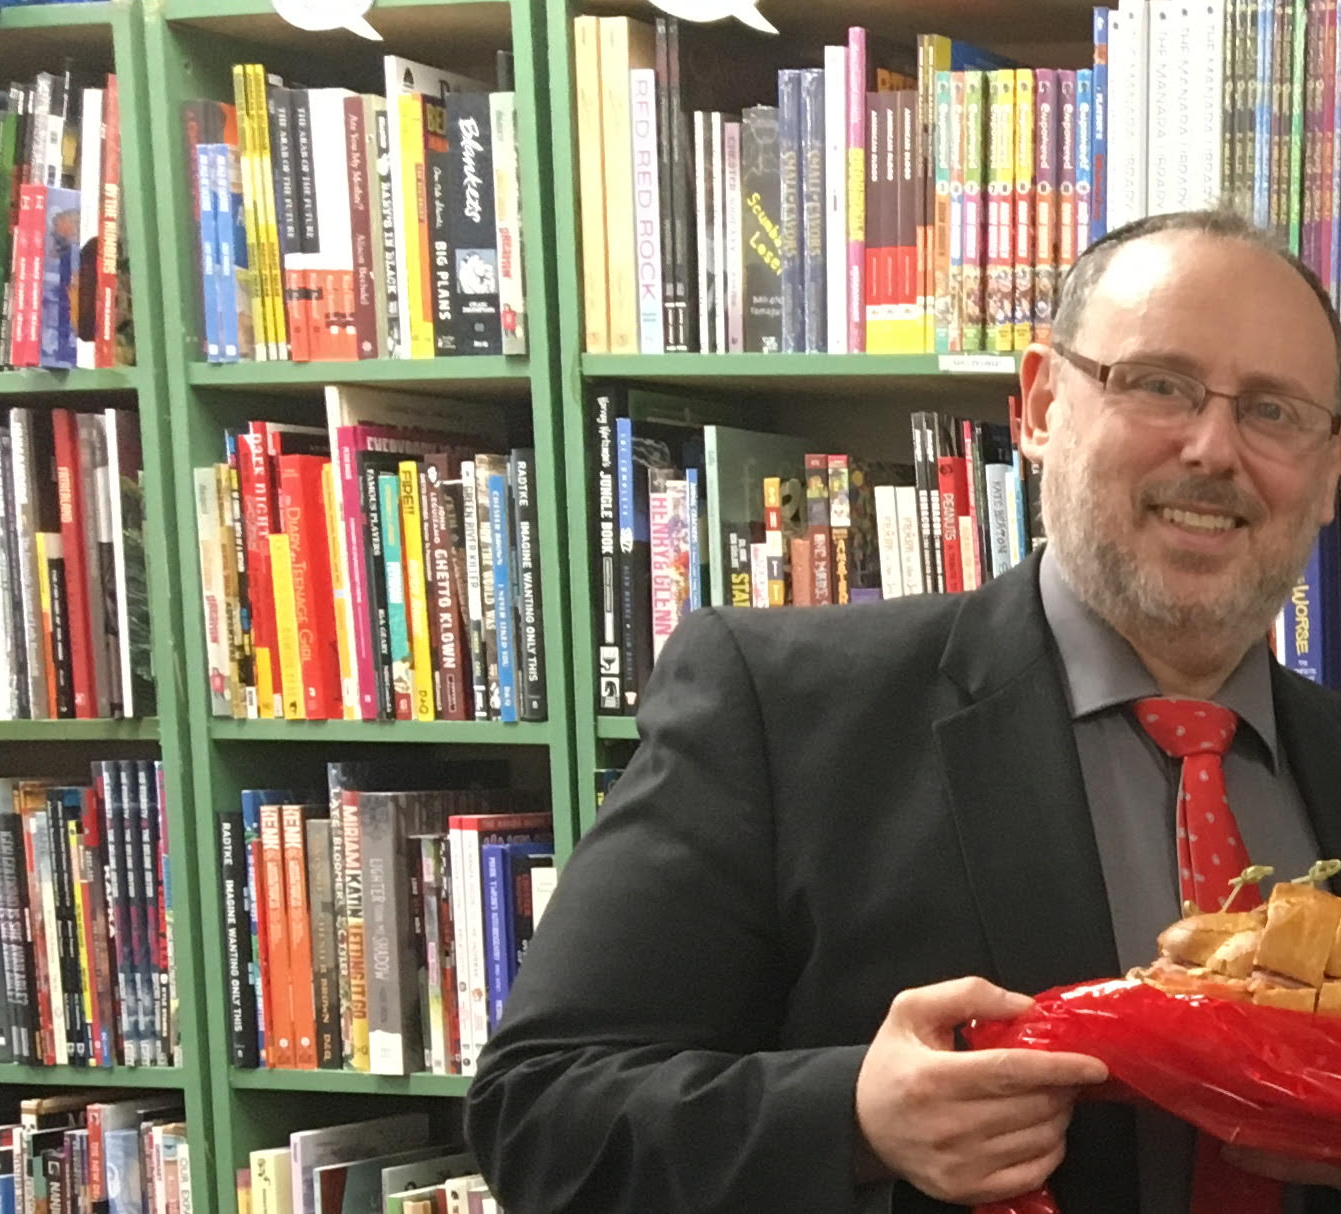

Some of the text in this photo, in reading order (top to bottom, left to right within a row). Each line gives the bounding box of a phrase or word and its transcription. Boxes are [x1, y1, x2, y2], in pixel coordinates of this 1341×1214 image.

[459, 116, 482, 223] Blankets
[434, 241, 447, 267] BIG
[436, 271, 452, 321] PLANS
[600, 471, 613, 555] JUNGLE BOOK
[941, 493, 955, 541] PEANUTS
[517, 461, 539, 682] RADTKE IMAGINE WANTING ONLY THIS
[435, 548, 456, 669] GHETTO KLOWN
[261, 806, 278, 850] KENK
[283, 806, 300, 850] KENK
[342, 805, 364, 917] MIRIAM KATIN
[221, 822, 243, 1033] RADTKE IMAGINE WANTING ONLY THIS
[178, 1156, 191, 1186] OUR
